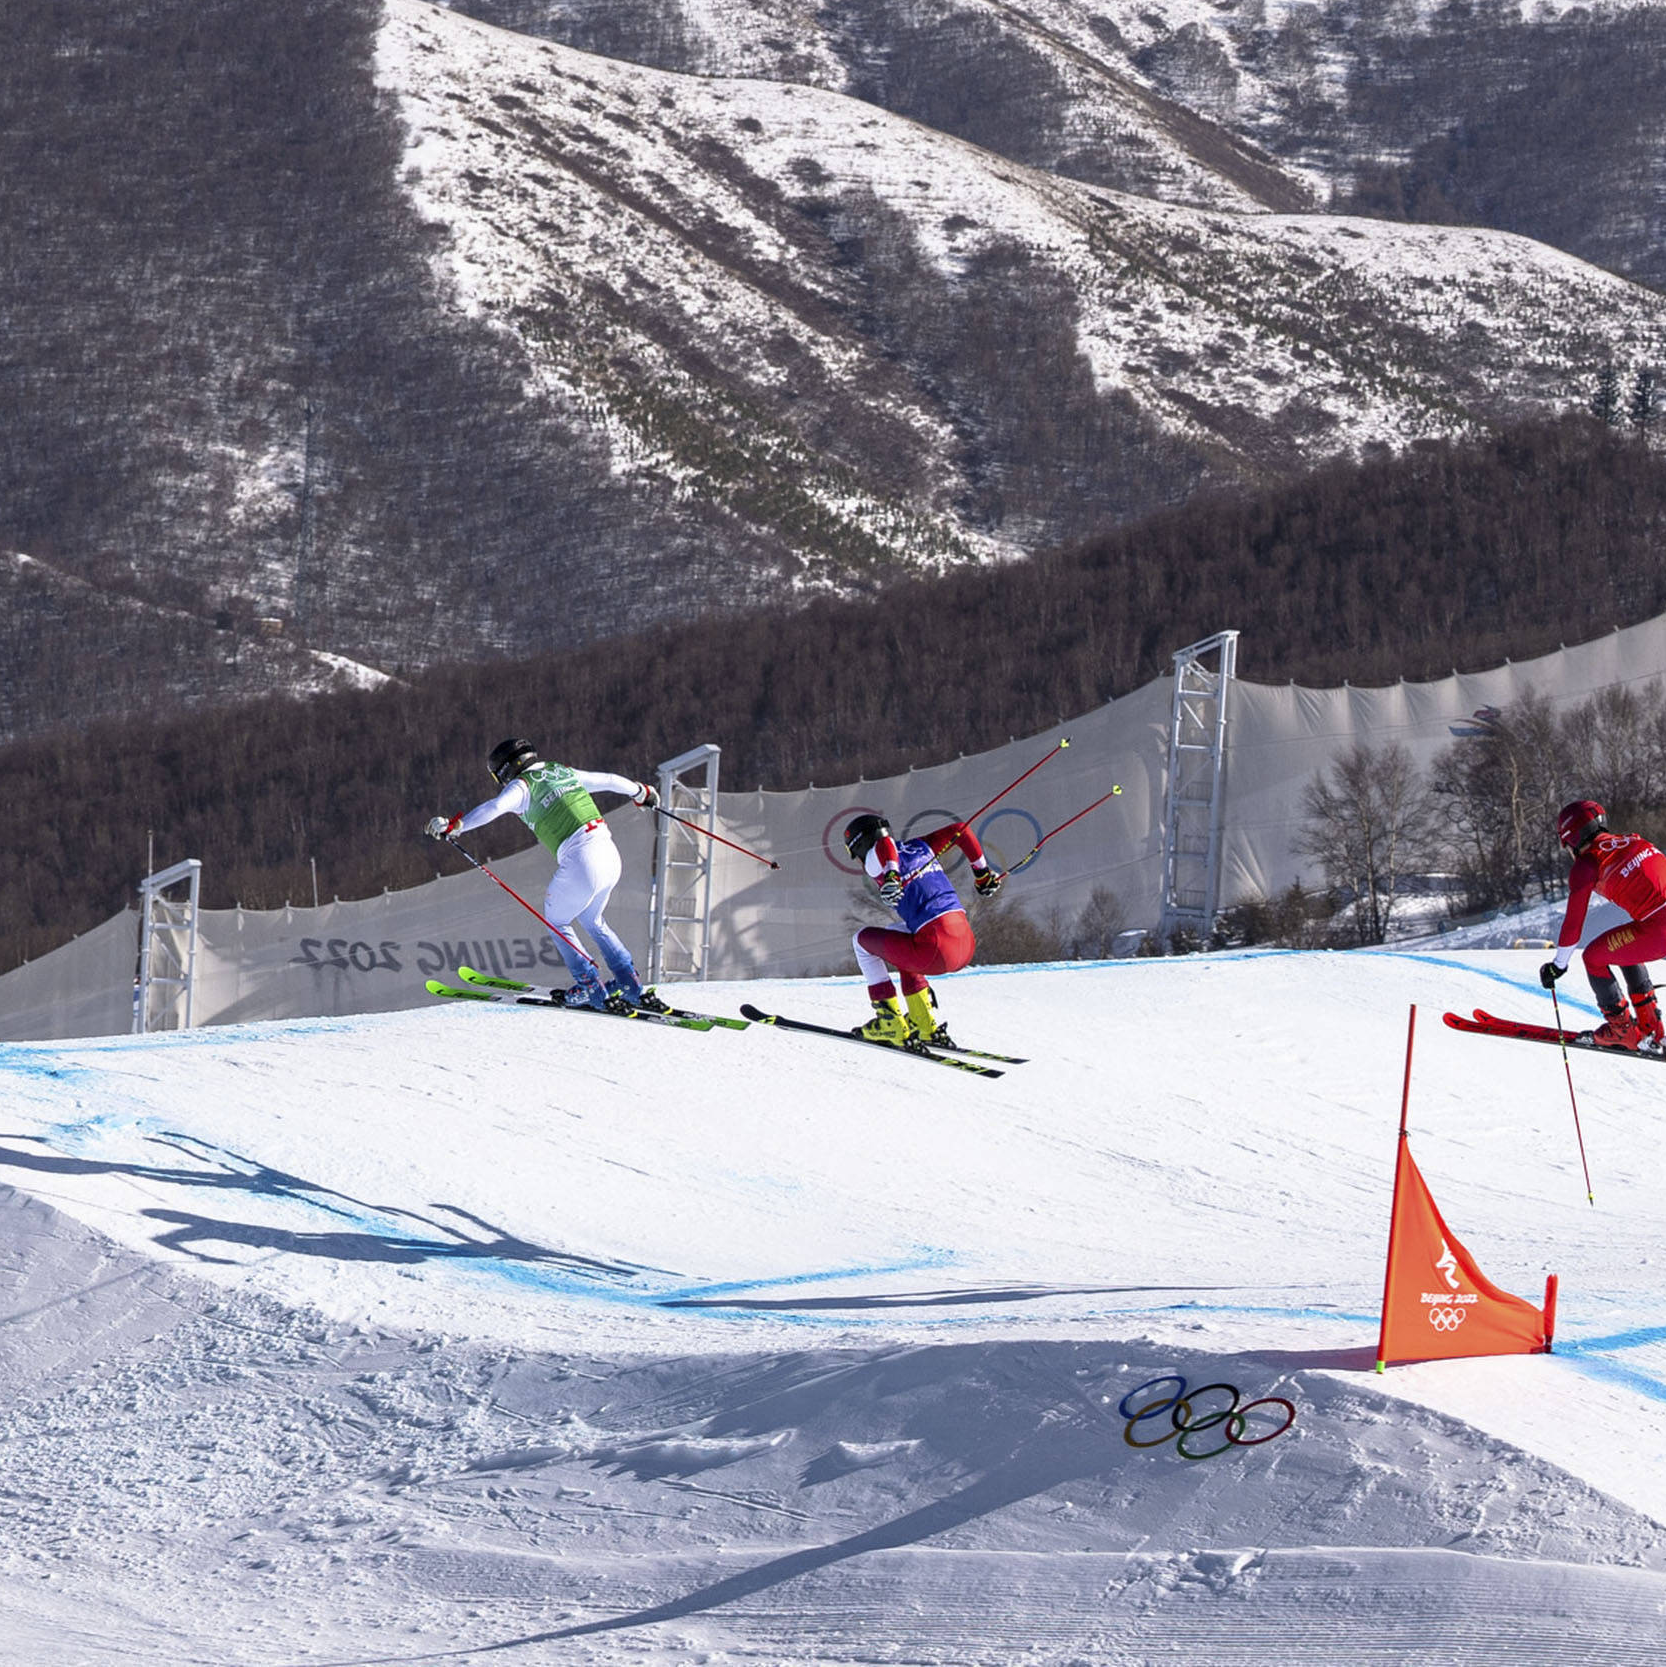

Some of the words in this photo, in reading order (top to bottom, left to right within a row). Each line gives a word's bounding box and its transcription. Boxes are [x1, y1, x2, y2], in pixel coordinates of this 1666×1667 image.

[1620, 847, 1653, 878] BEIJING
[1606, 928, 1636, 952] JAPAN
[1420, 1292, 1453, 1306] BEIJING
[1453, 1294, 1479, 1304] 2022
